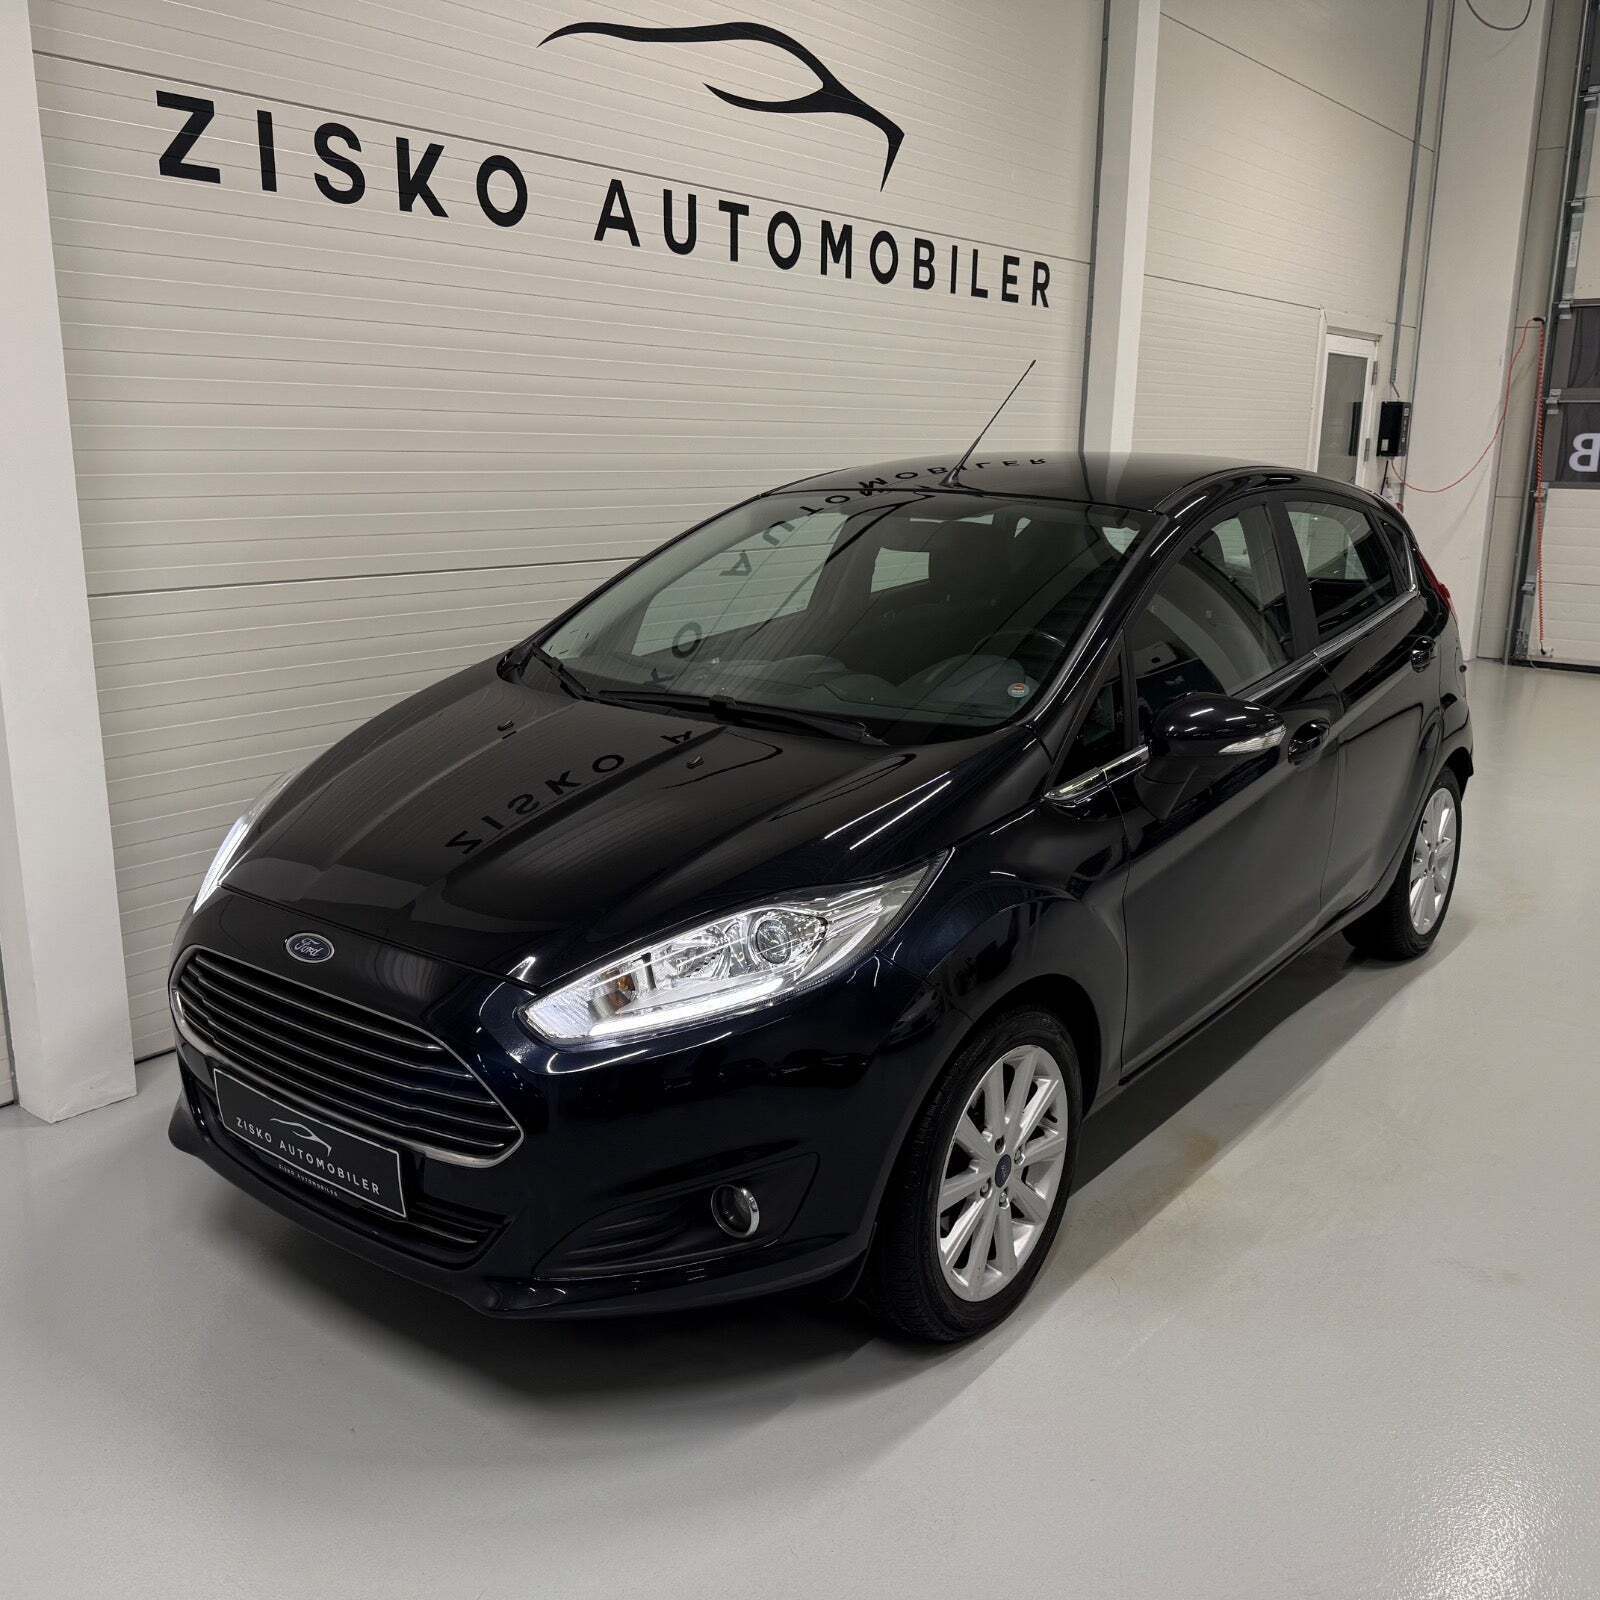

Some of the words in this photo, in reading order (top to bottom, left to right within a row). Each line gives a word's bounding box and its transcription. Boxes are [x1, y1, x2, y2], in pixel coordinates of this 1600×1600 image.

[156, 90, 528, 228] ZISKO
[595, 179, 1051, 308] AUTOMOBILER
[294, 937, 324, 957] Ford
[236, 1117, 272, 1143] ZISKO
[279, 1140, 380, 1195] AUTOMOBILER
